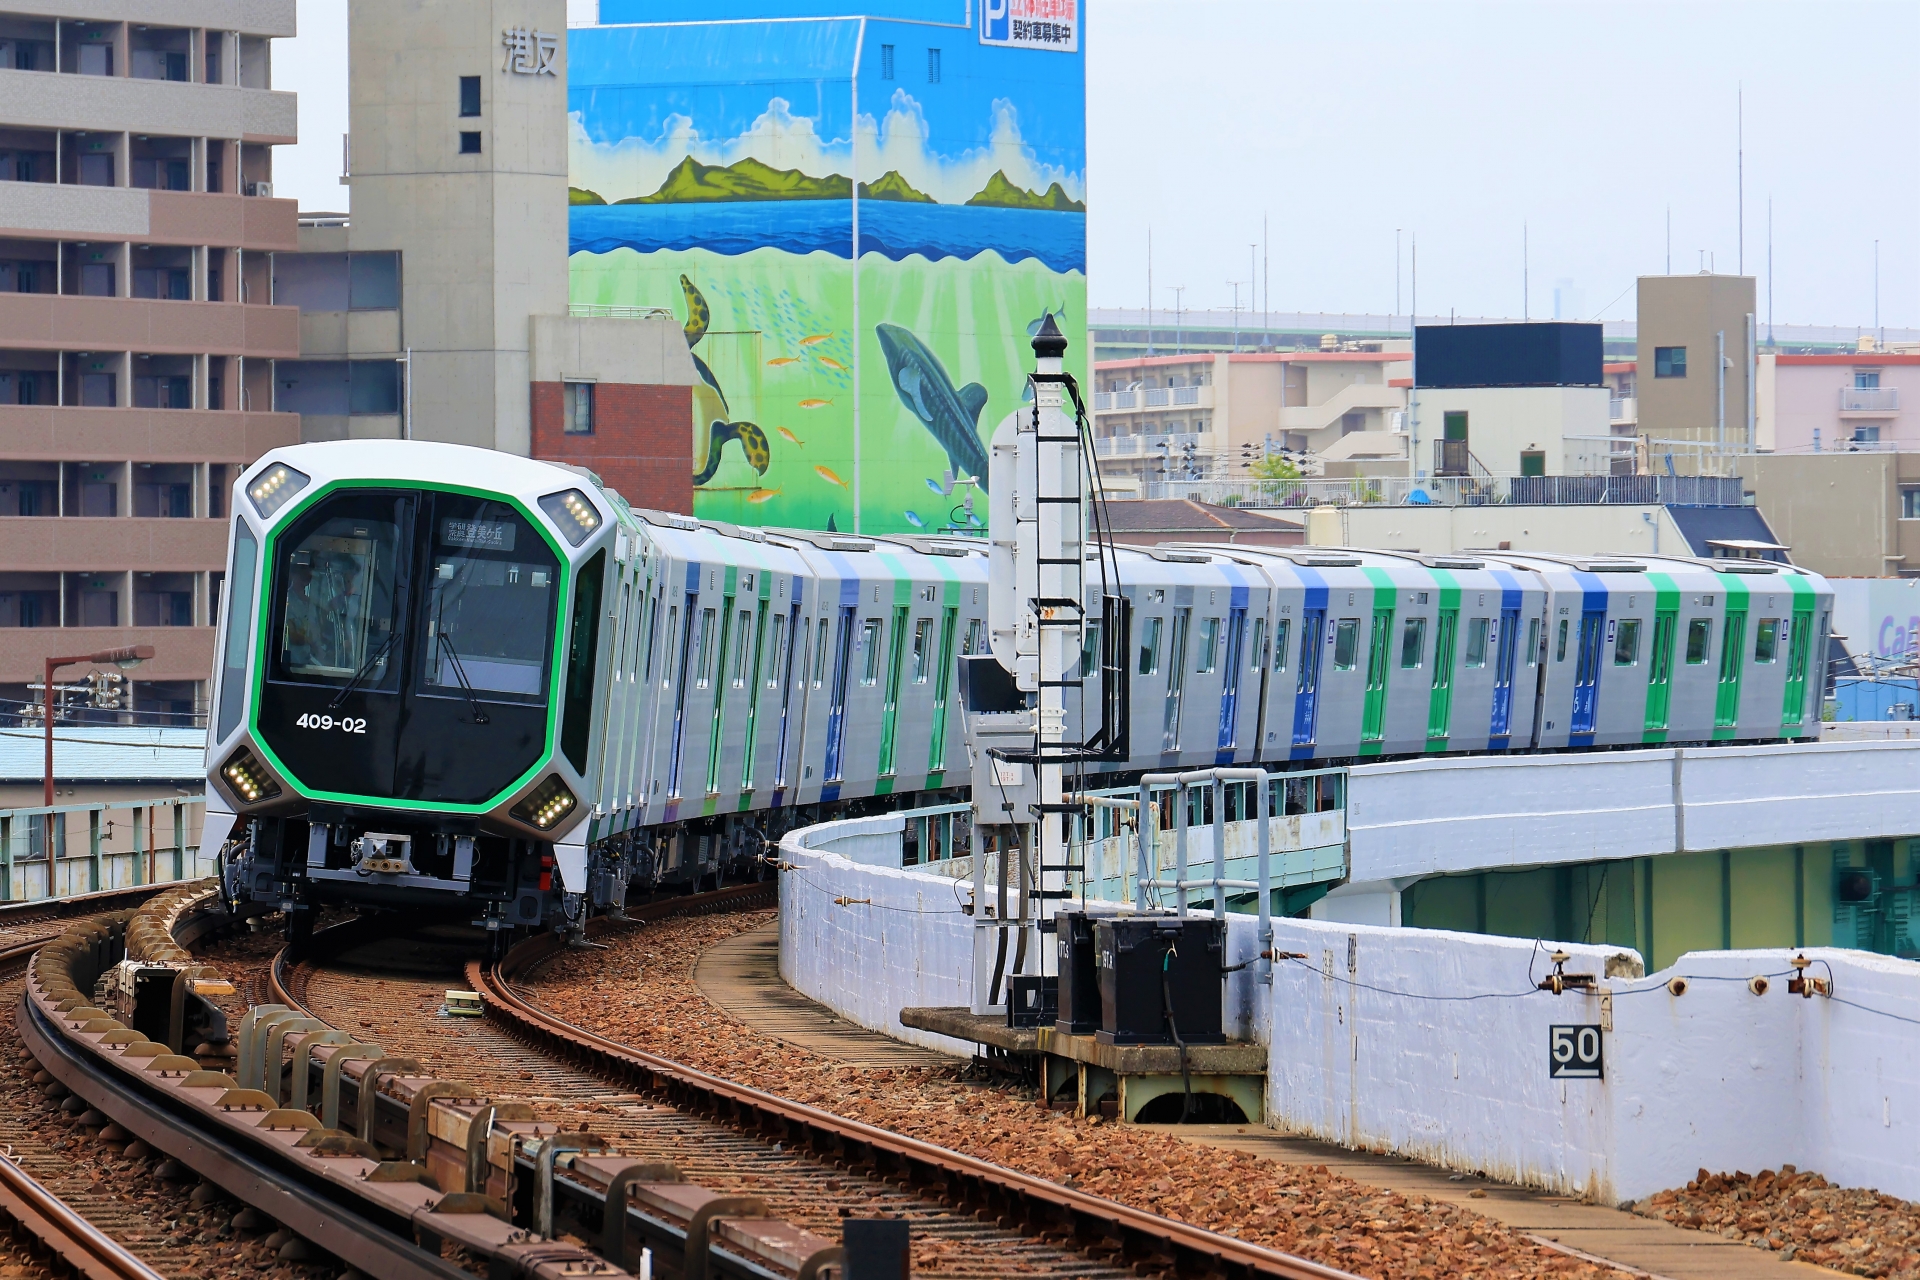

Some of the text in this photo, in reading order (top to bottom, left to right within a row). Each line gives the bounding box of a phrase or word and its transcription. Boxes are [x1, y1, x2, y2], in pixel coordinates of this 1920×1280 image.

[1012, 19, 1071, 44] 契約車募集中
[503, 25, 559, 76] 港友
[296, 713, 367, 734] 409-02
[1552, 1027, 1600, 1063] 50
